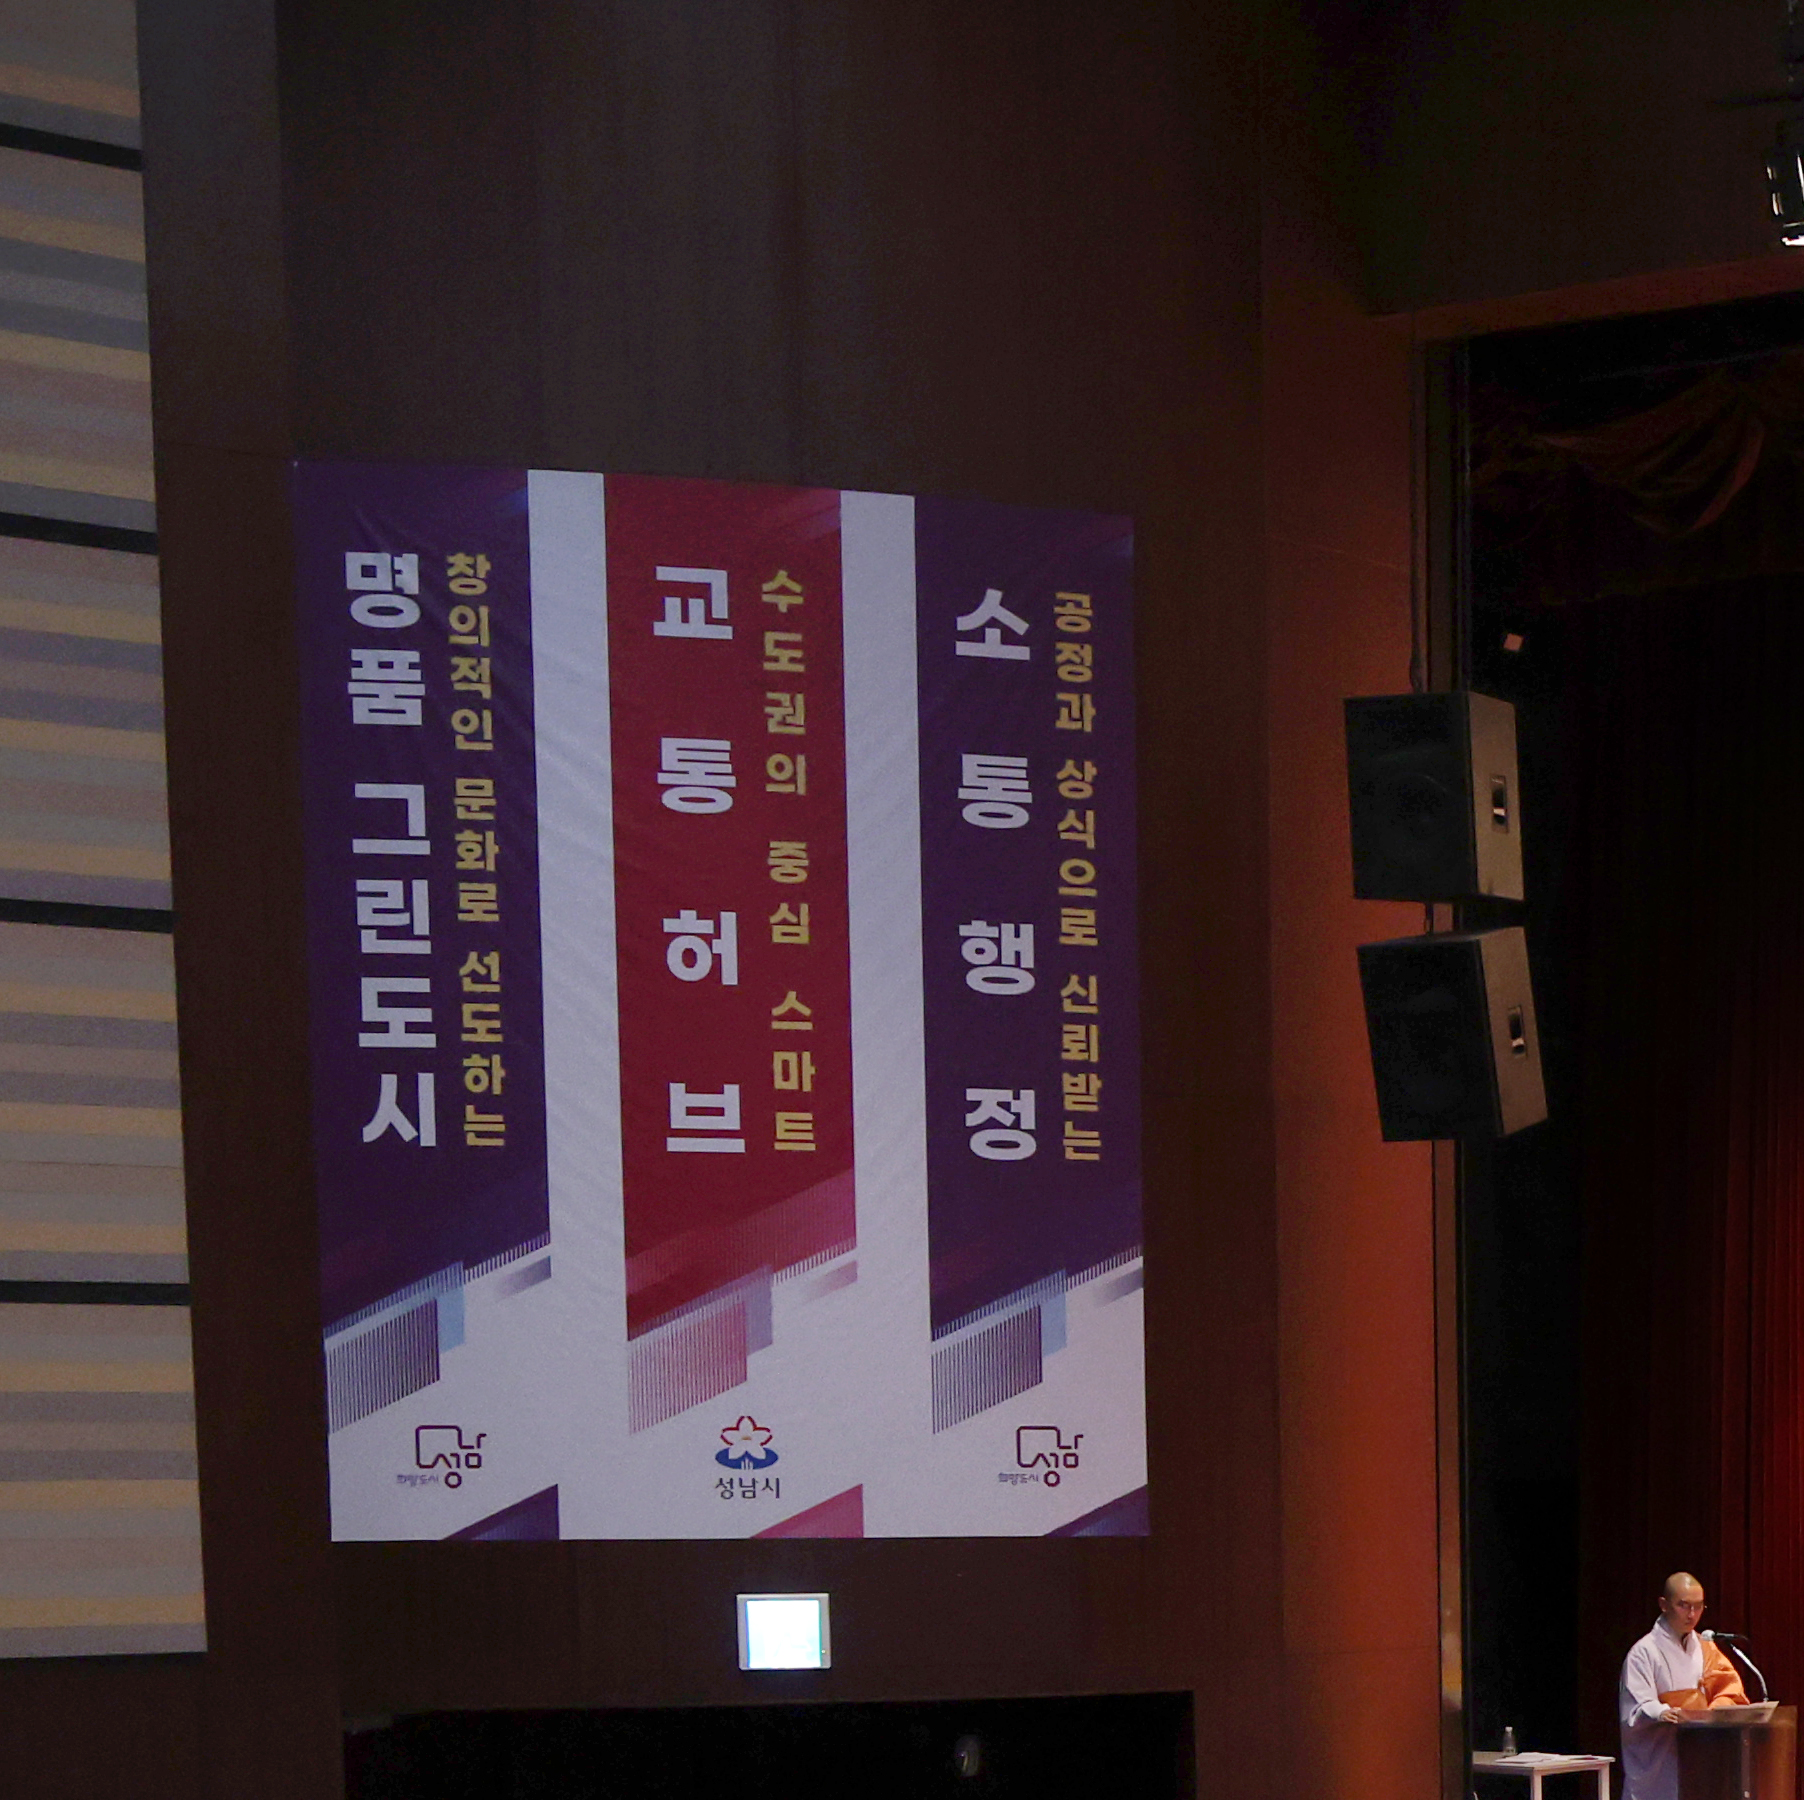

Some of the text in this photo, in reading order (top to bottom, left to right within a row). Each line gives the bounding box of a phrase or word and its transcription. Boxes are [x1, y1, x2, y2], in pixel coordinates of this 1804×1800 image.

[345, 551, 437, 1147] 명품 그린도시
[446, 552, 506, 1147] 창의적인 문화로 선도하는
[761, 569, 817, 1152] 수도권의 중심 스마트
[1053, 591, 1103, 1161] 공정과 상식으로 신뢰받는
[715, 1477, 780, 1500] 성남시
